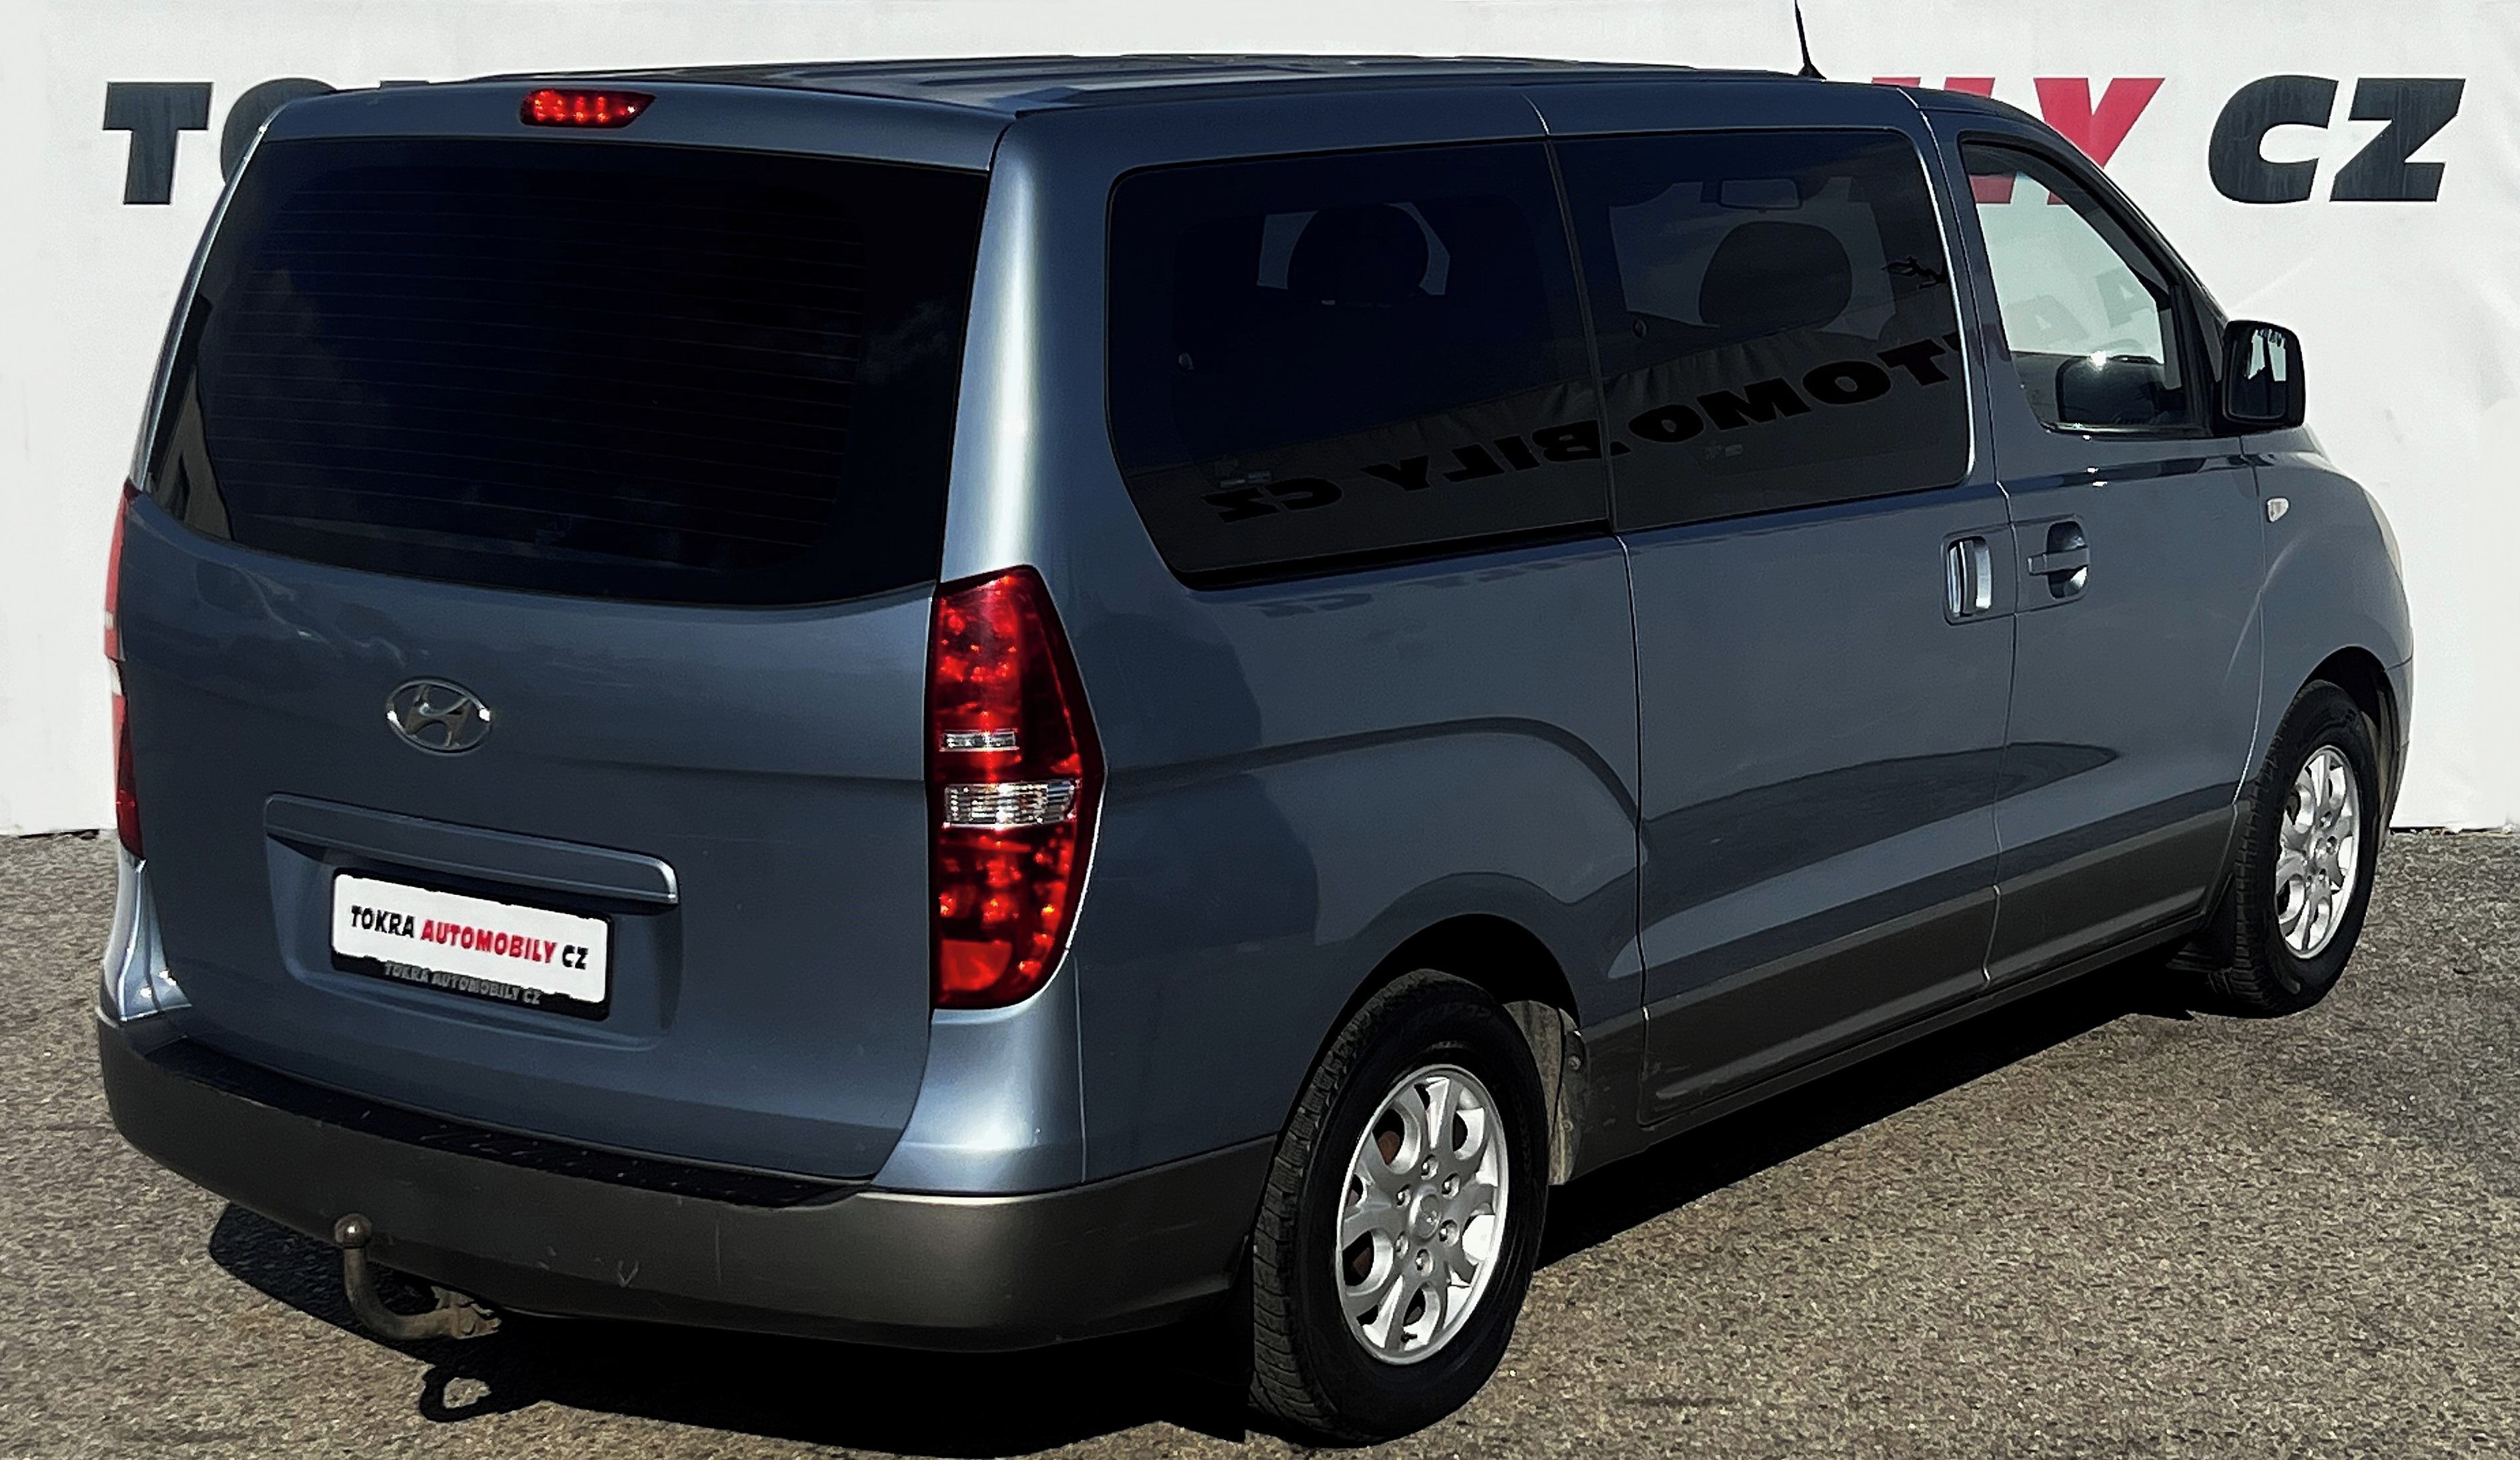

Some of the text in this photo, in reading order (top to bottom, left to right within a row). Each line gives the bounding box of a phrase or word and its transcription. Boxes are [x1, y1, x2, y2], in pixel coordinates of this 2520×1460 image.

[2208, 75, 2467, 204] CZ
[351, 905, 588, 970] TOKRA AUTOMOBILY CZ
[384, 961, 541, 1005] TOKRA AUTOMOBILY CZ
